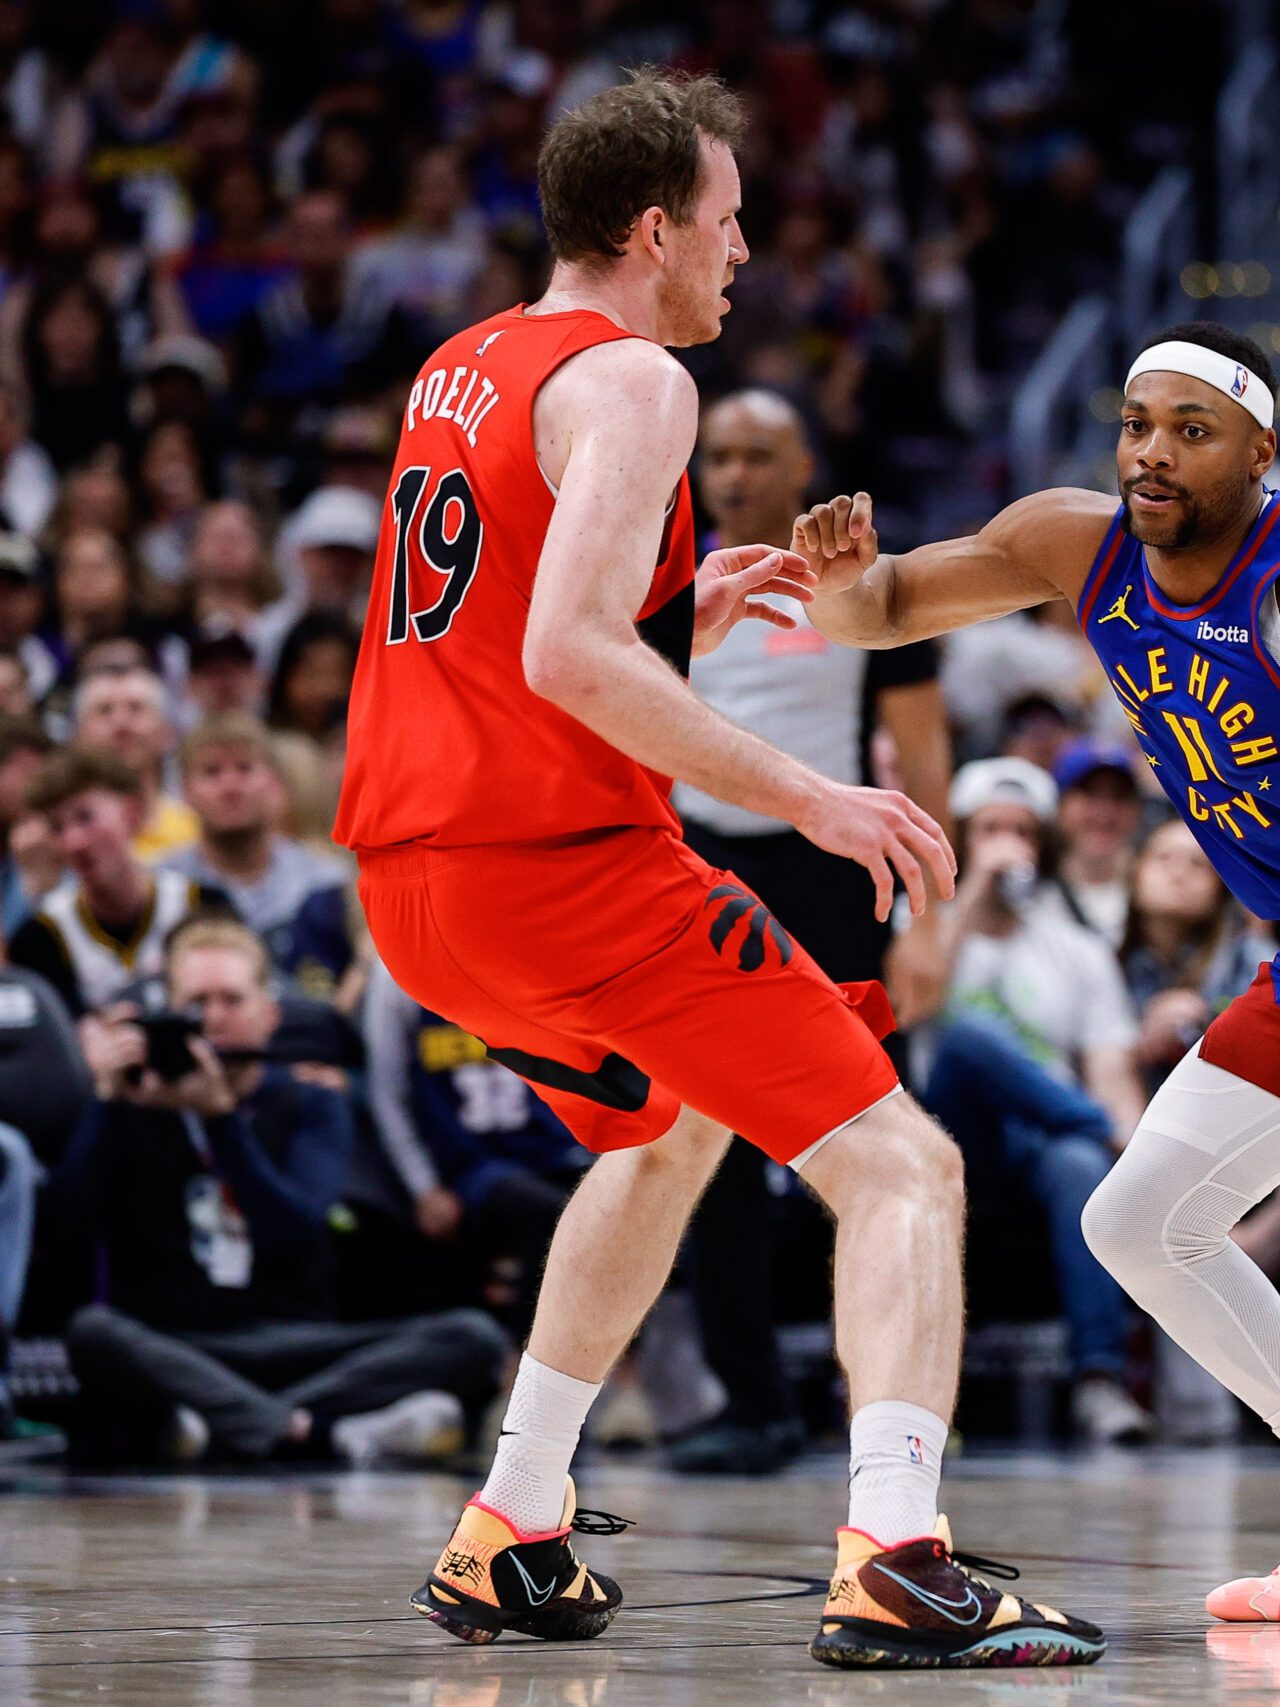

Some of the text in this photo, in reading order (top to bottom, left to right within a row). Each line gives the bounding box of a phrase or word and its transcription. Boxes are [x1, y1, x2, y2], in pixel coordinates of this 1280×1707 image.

[407, 366, 499, 448] POELTL
[386, 466, 483, 645] 19
[1196, 621, 1248, 643] ibotta
[1161, 709, 1228, 783] 11
[1187, 653, 1278, 766] HIGH
